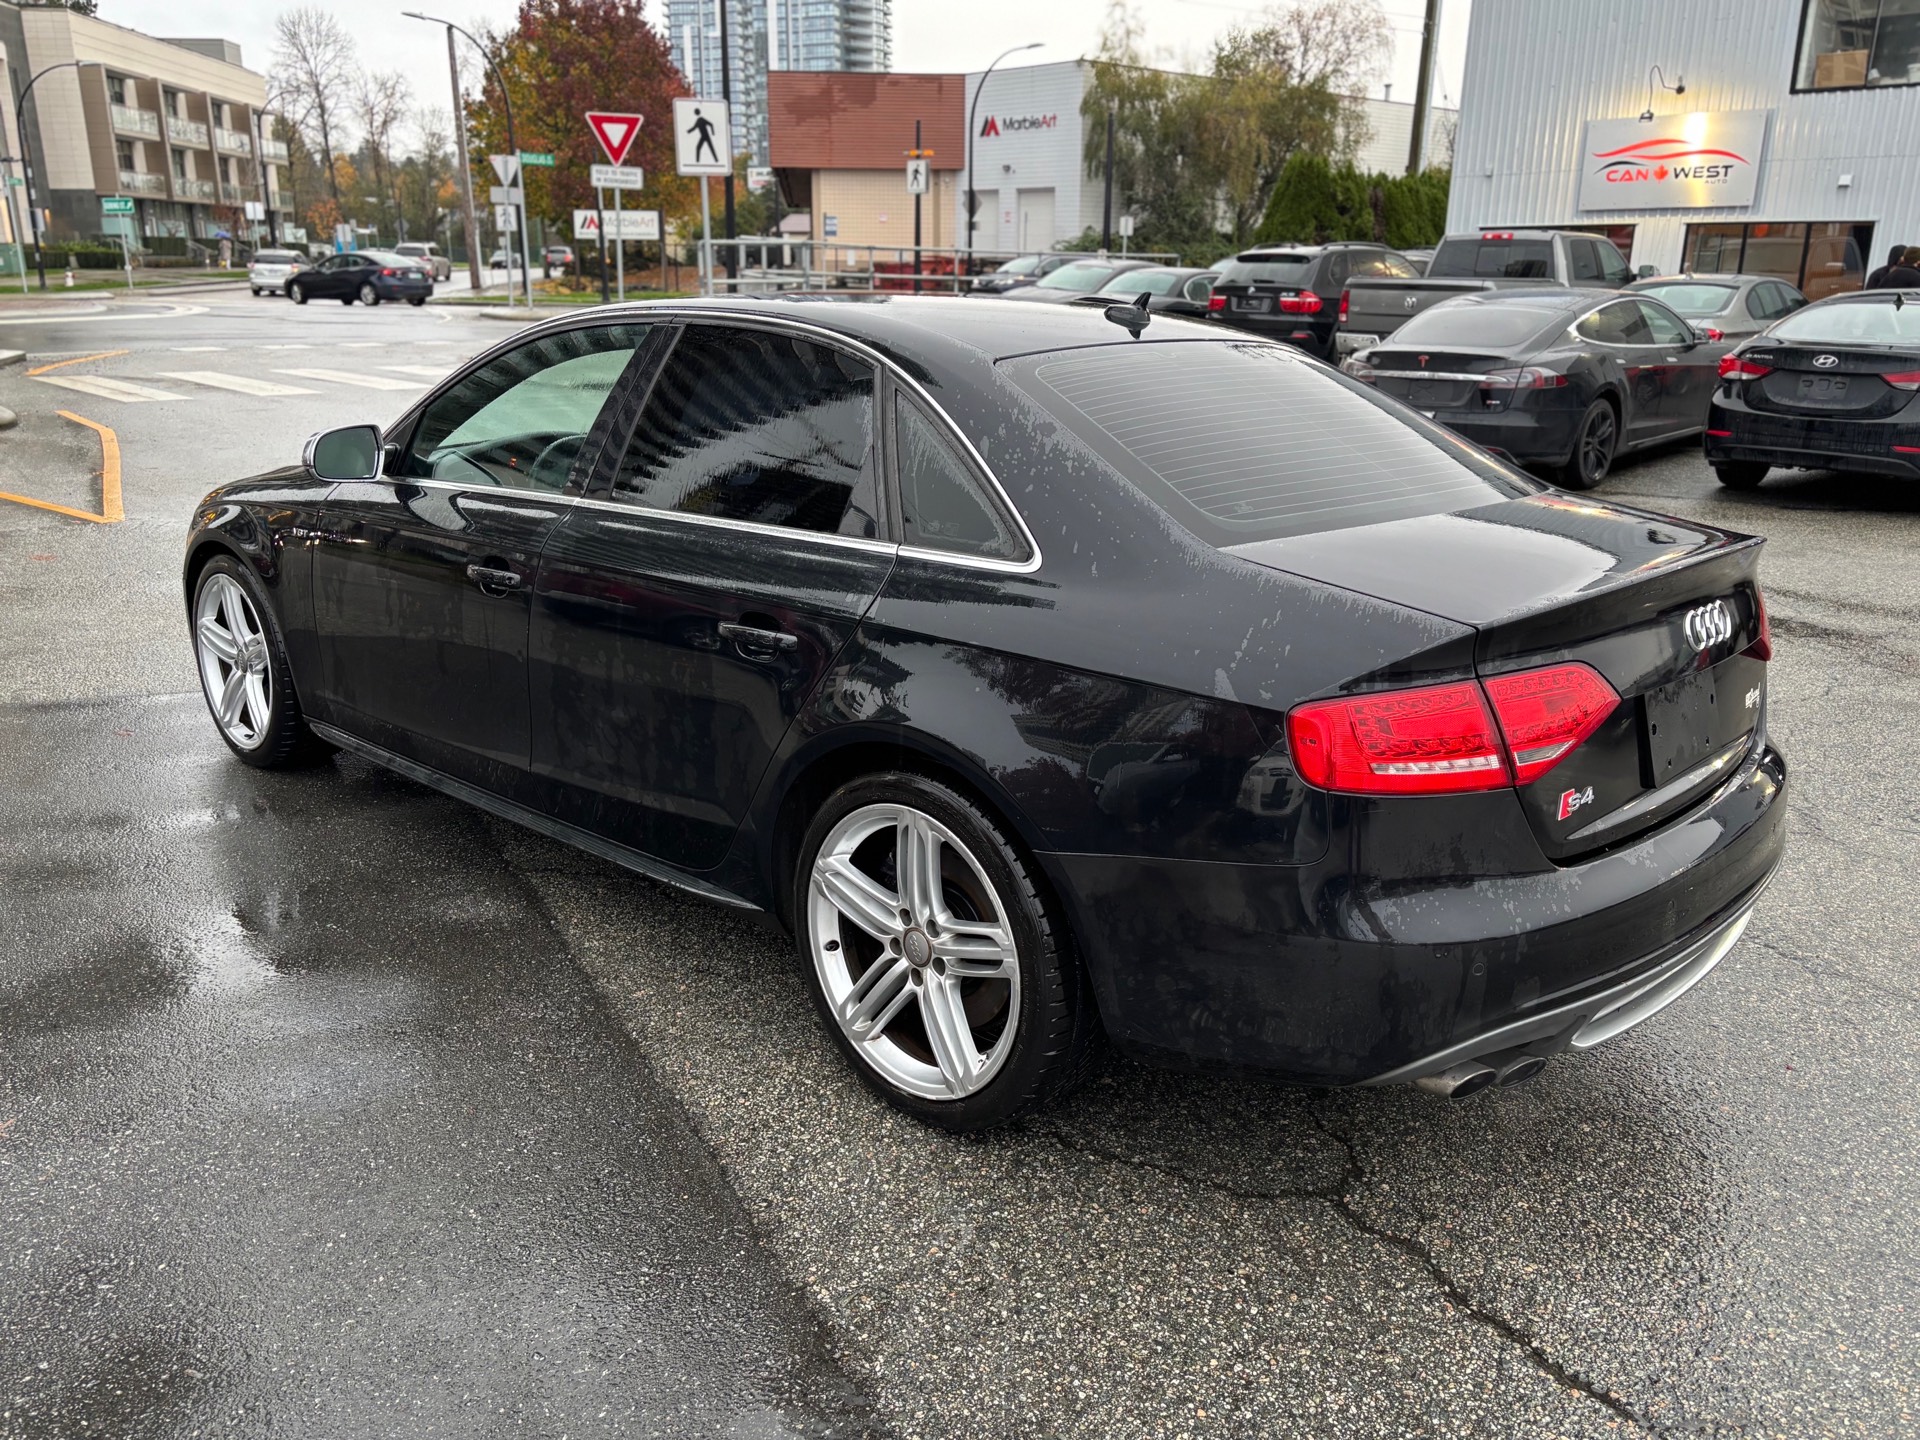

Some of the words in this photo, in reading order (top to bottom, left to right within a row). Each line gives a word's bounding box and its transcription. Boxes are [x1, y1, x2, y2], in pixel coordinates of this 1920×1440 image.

[1002, 114, 1057, 131] MarbleArt
[1605, 168, 1649, 182] CAN
[1673, 164, 1734, 179] WEST
[602, 216, 655, 228] MableArt
[1568, 786, 1595, 812] S4
